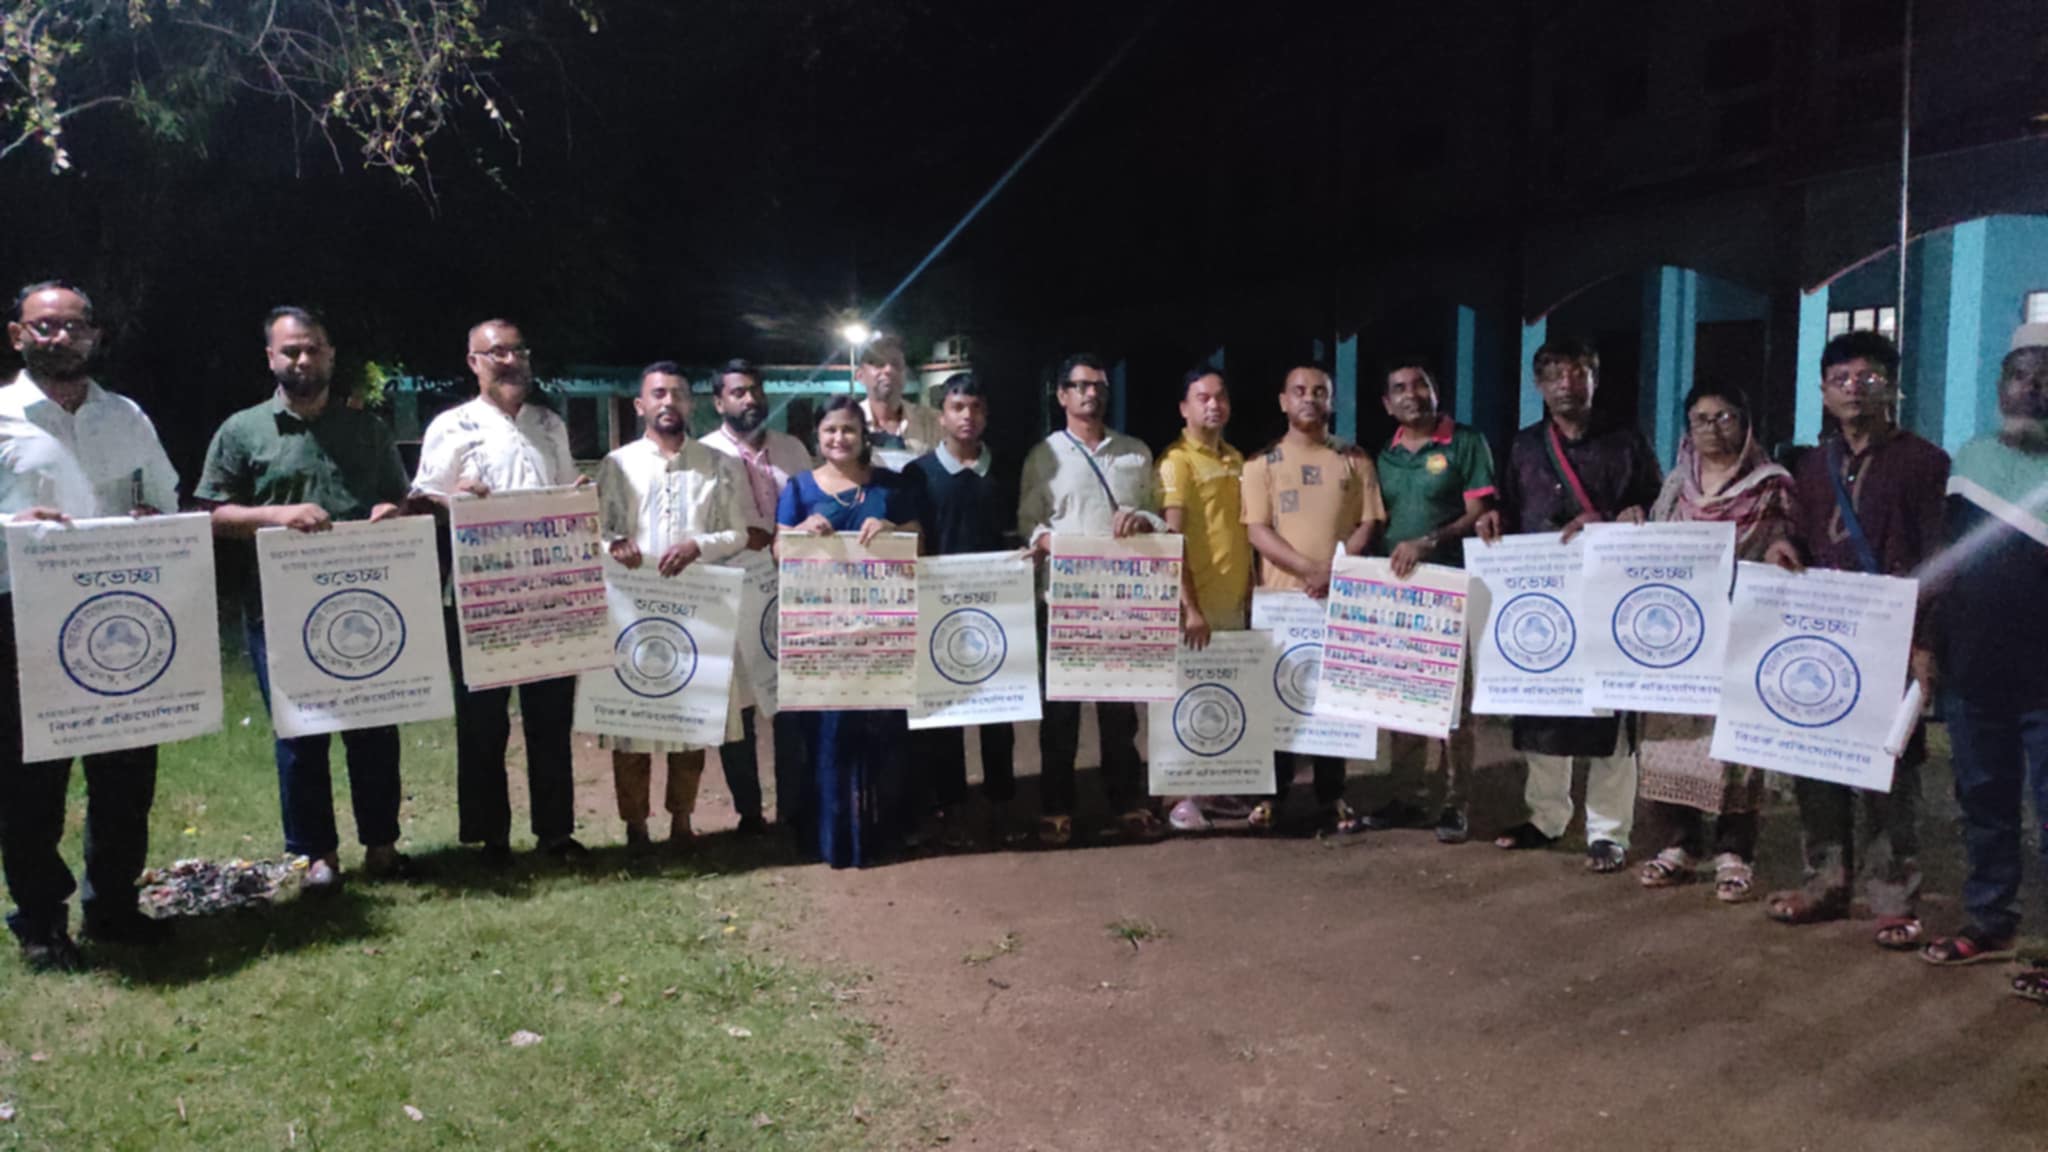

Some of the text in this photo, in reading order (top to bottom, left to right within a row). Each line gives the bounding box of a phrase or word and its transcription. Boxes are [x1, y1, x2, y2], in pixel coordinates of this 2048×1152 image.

[72, 565, 162, 588] শুভেচ্ছা
[312, 566, 391, 586] শুভেচ্ছা
[633, 597, 699, 618] শুভেচ্ছা
[1781, 613, 1859, 637] শুভেচ্ছা
